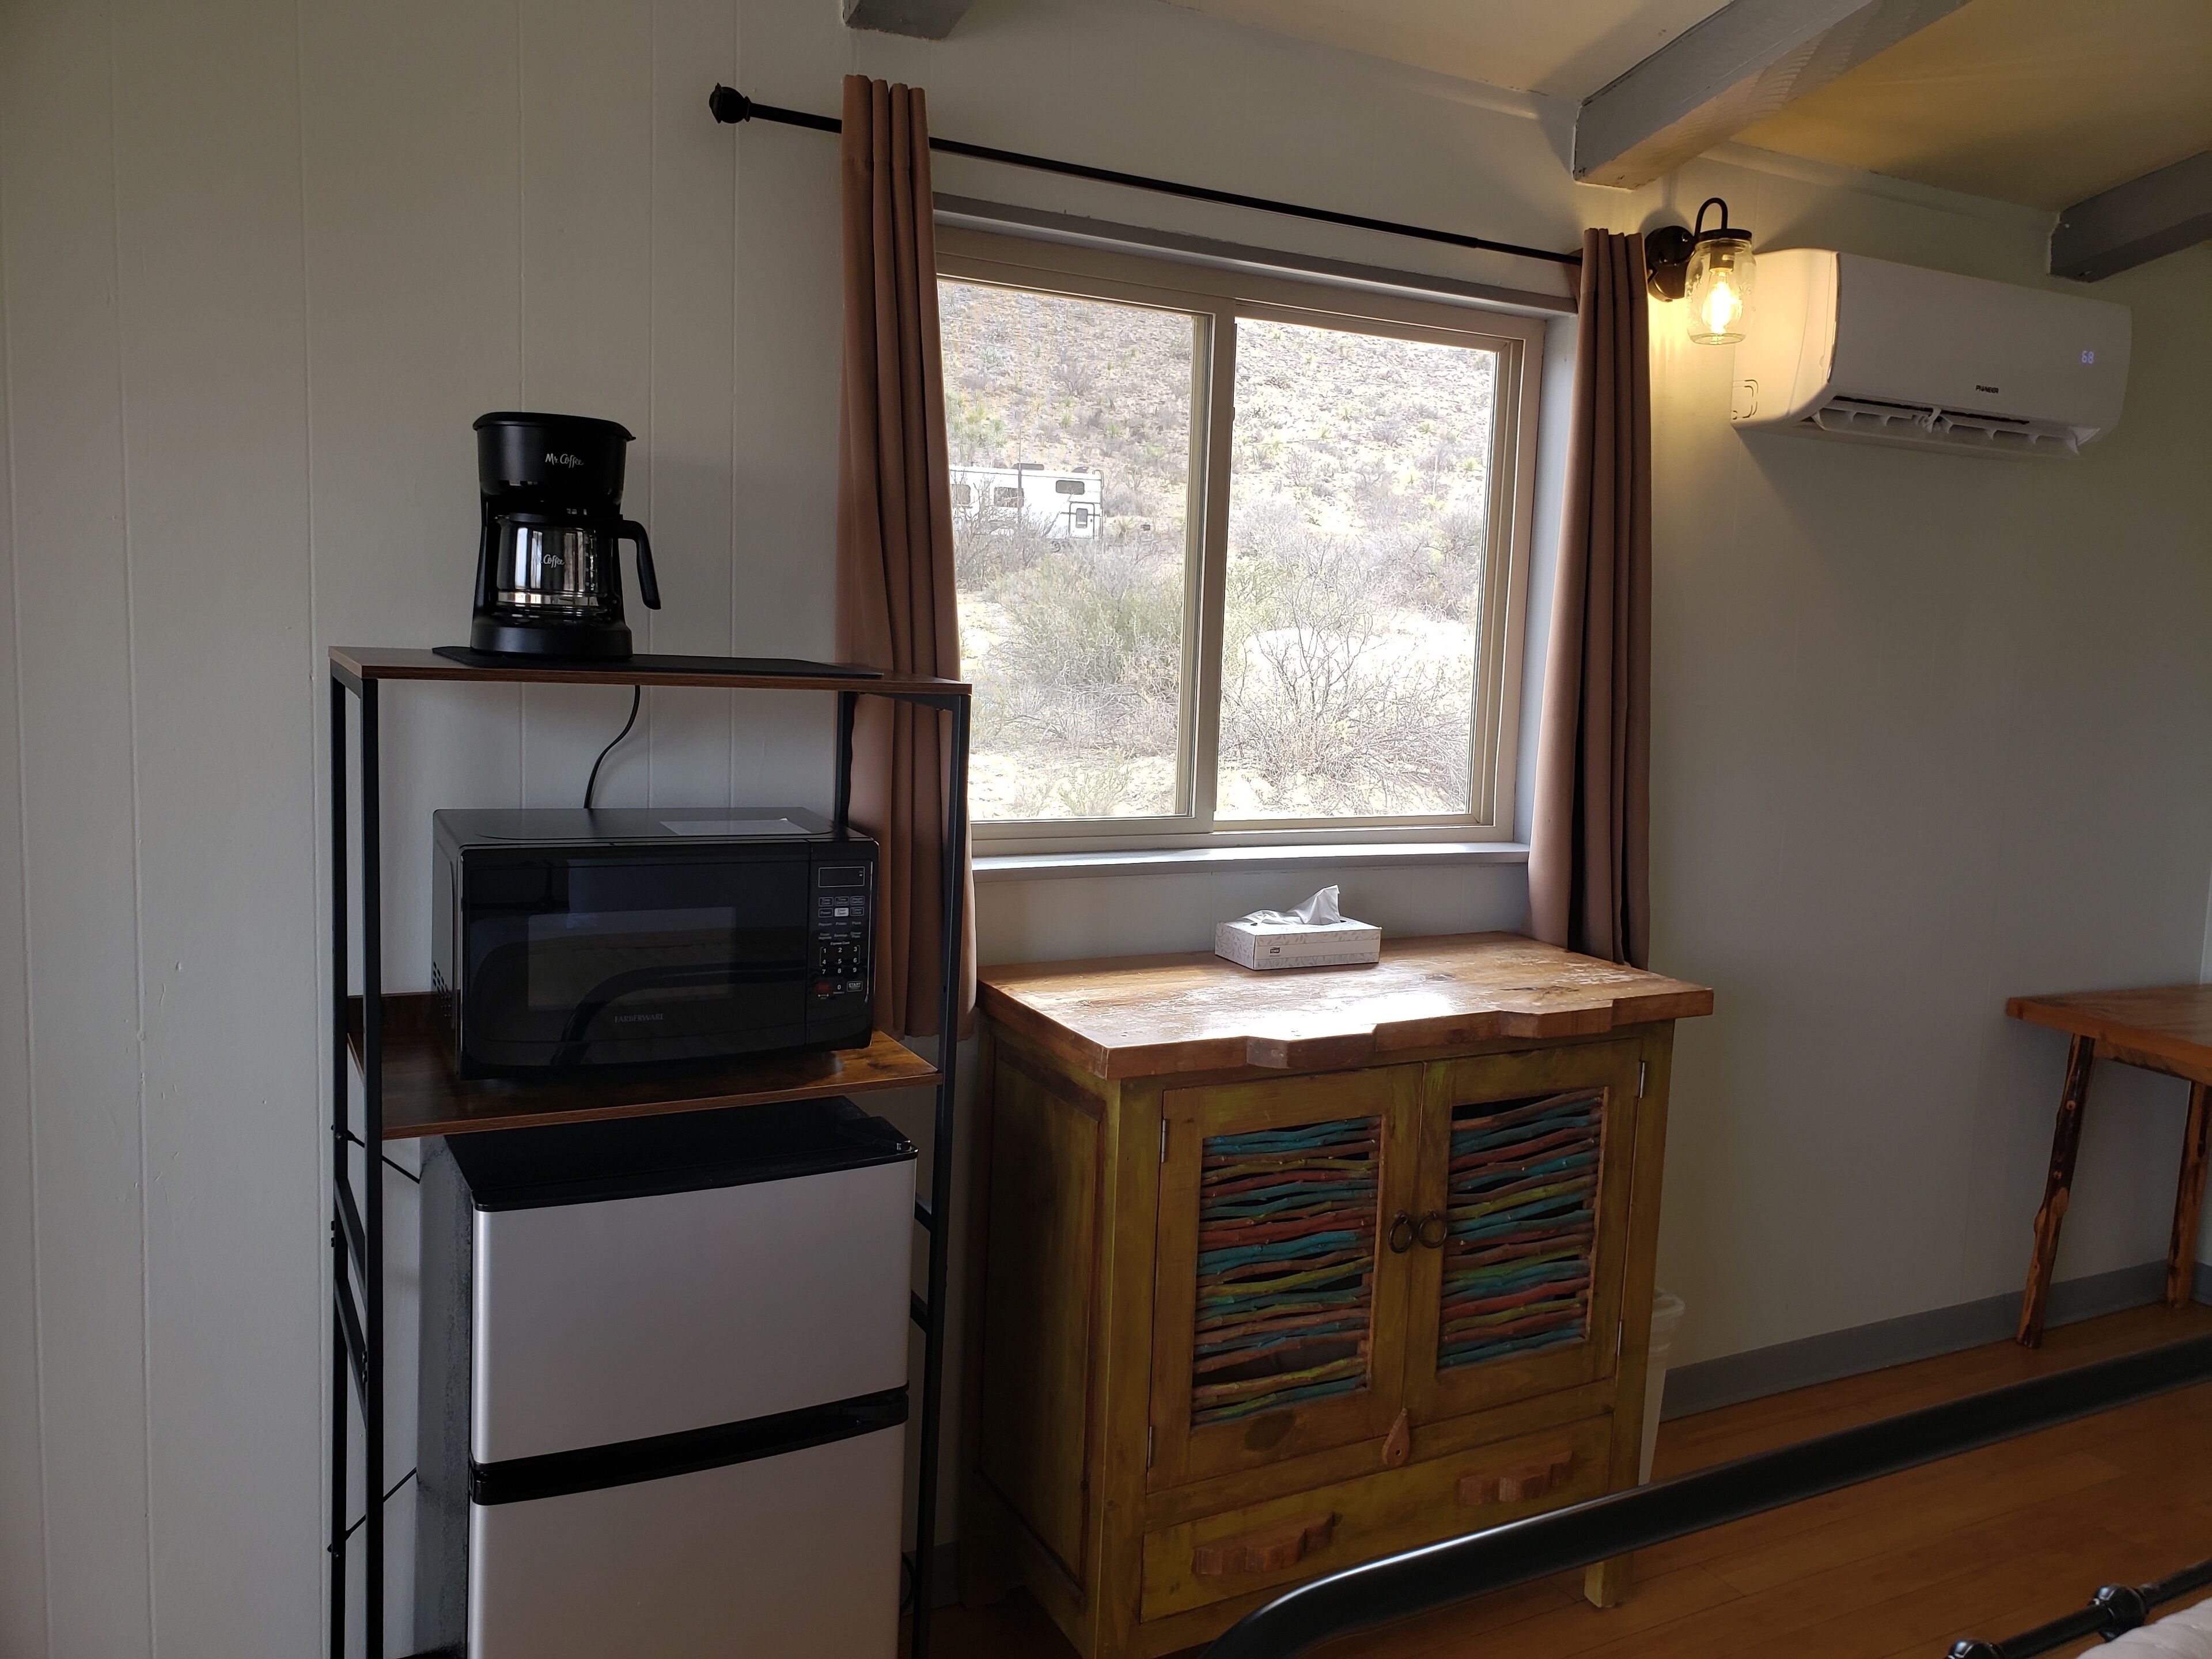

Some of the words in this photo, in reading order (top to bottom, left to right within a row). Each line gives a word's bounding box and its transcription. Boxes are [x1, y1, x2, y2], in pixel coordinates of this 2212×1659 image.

[2082, 350, 2094, 364] 68
[1976, 385, 1999, 394] PIONEER
[545, 453, 559, 465] Mr.
[560, 453, 584, 468] Coffee
[543, 554, 565, 569] Coffee
[615, 1013, 664, 1023] FARBERWARE
